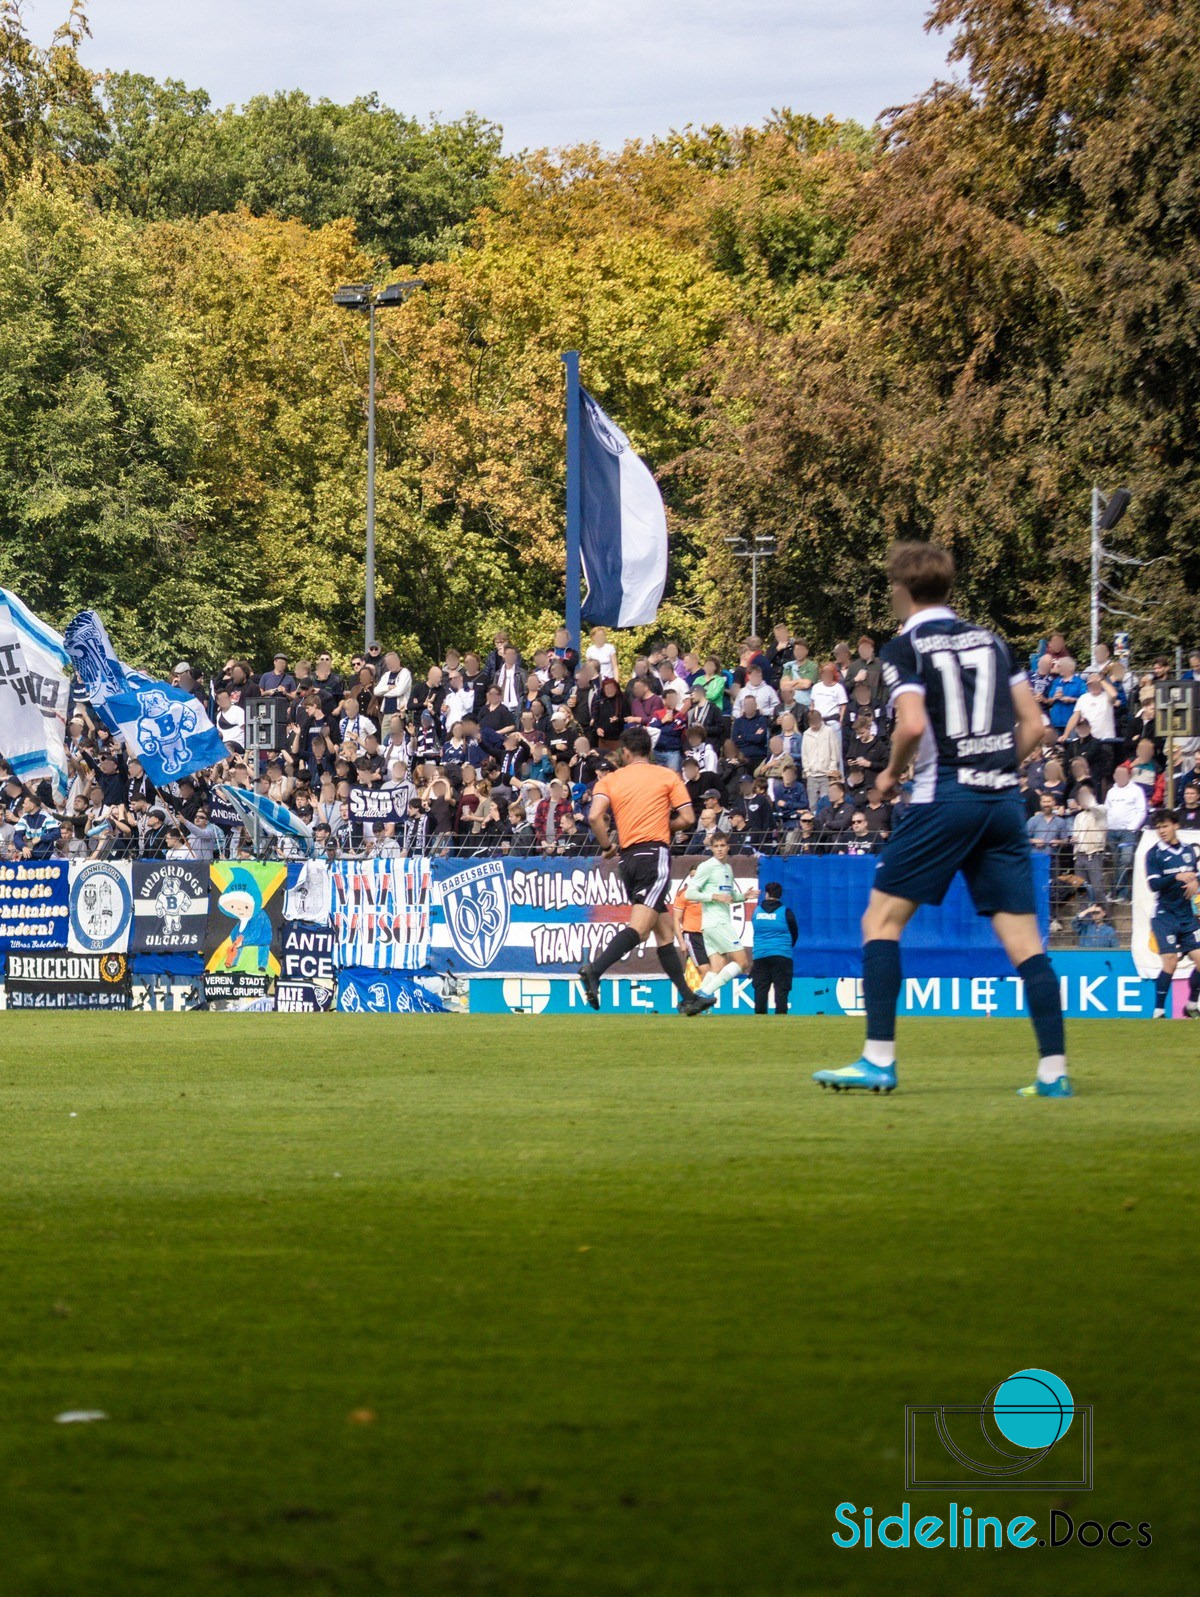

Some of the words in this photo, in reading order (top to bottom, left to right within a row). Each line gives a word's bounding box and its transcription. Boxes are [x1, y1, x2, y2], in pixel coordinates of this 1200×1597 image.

[931, 646, 996, 739] 17
[141, 865, 204, 897] UNDERDOGS
[441, 862, 502, 892] BABELSBERG
[12, 887, 29, 899] es
[30, 884, 53, 898] die
[166, 896, 178, 909] B
[455, 888, 503, 945] 03
[146, 934, 198, 946] ULTRAS
[285, 932, 332, 953] ANTI
[531, 923, 585, 966] THAN
[8, 955, 101, 980] BRICCONI
[285, 954, 334, 978] FCE
[239, 976, 265, 986] STADT.
[277, 987, 304, 1001] ALTE
